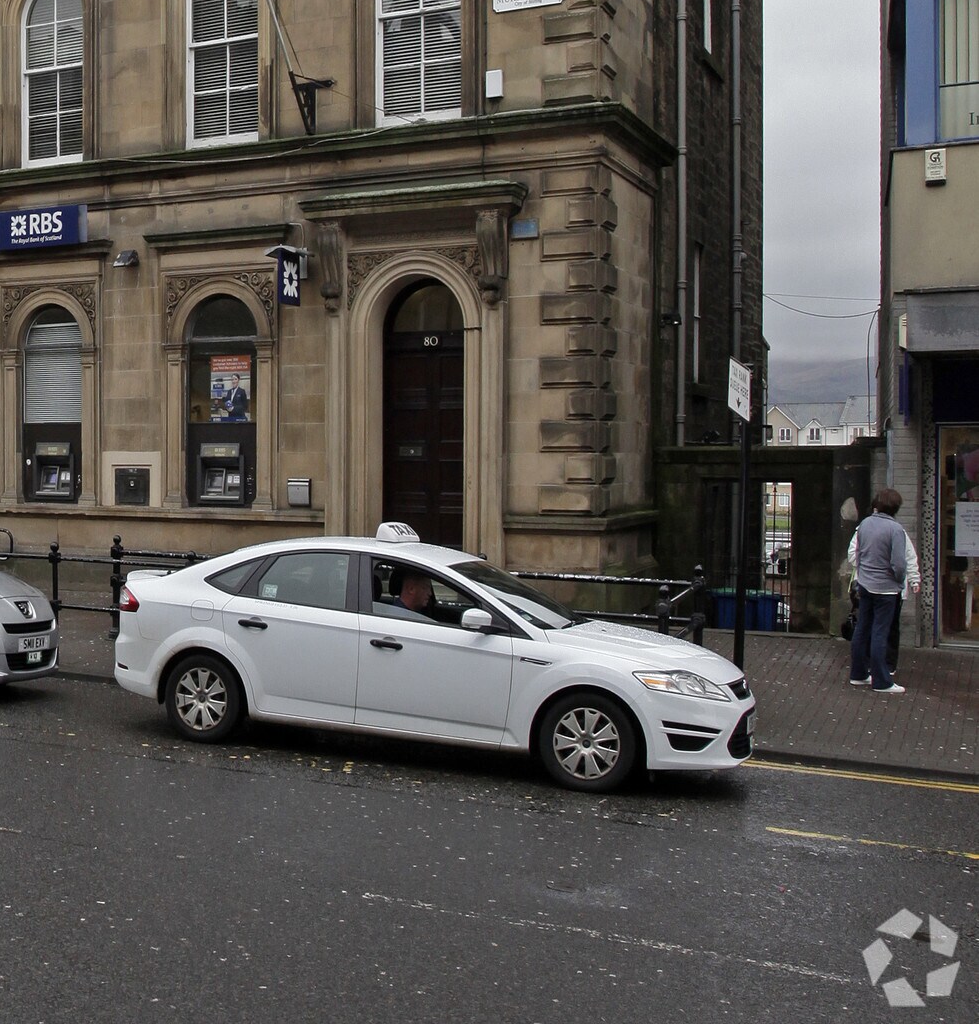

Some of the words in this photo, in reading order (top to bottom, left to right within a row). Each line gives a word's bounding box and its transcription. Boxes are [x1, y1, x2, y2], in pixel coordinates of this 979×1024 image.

[29, 211, 62, 235] RBS
[19, 237, 29, 245] Royal
[40, 235, 45, 243] of
[45, 234, 62, 242] Scotland
[424, 336, 438, 346] 80
[387, 524, 417, 536] TAXI
